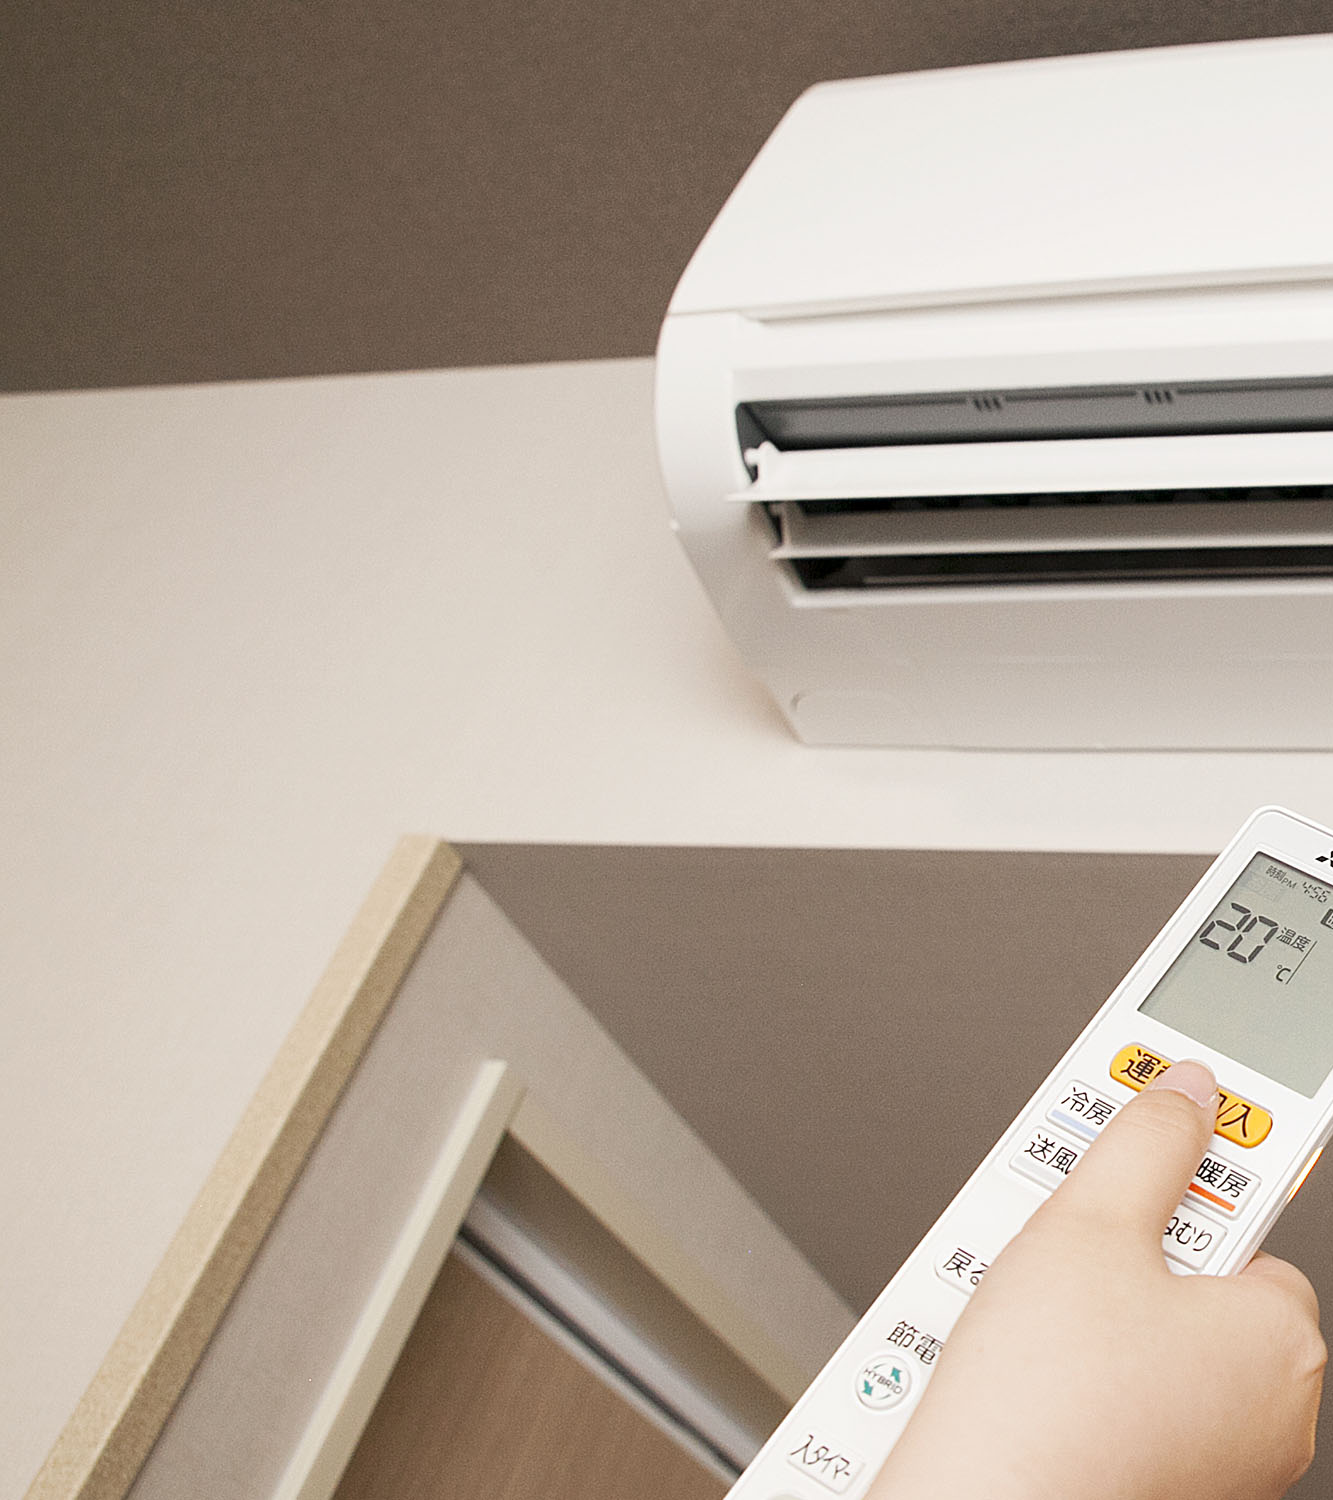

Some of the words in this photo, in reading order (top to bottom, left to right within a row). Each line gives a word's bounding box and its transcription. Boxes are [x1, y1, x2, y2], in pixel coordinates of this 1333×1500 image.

[1199, 902, 1279, 964] 20
[1276, 927, 1310, 953] 温度
[1061, 1087, 1117, 1125] 冷房
[1024, 1133, 1078, 1175] 送風
[1195, 1157, 1252, 1198] 暖房
[886, 1320, 945, 1365] 節電
[863, 1367, 903, 1396] HYBRID
